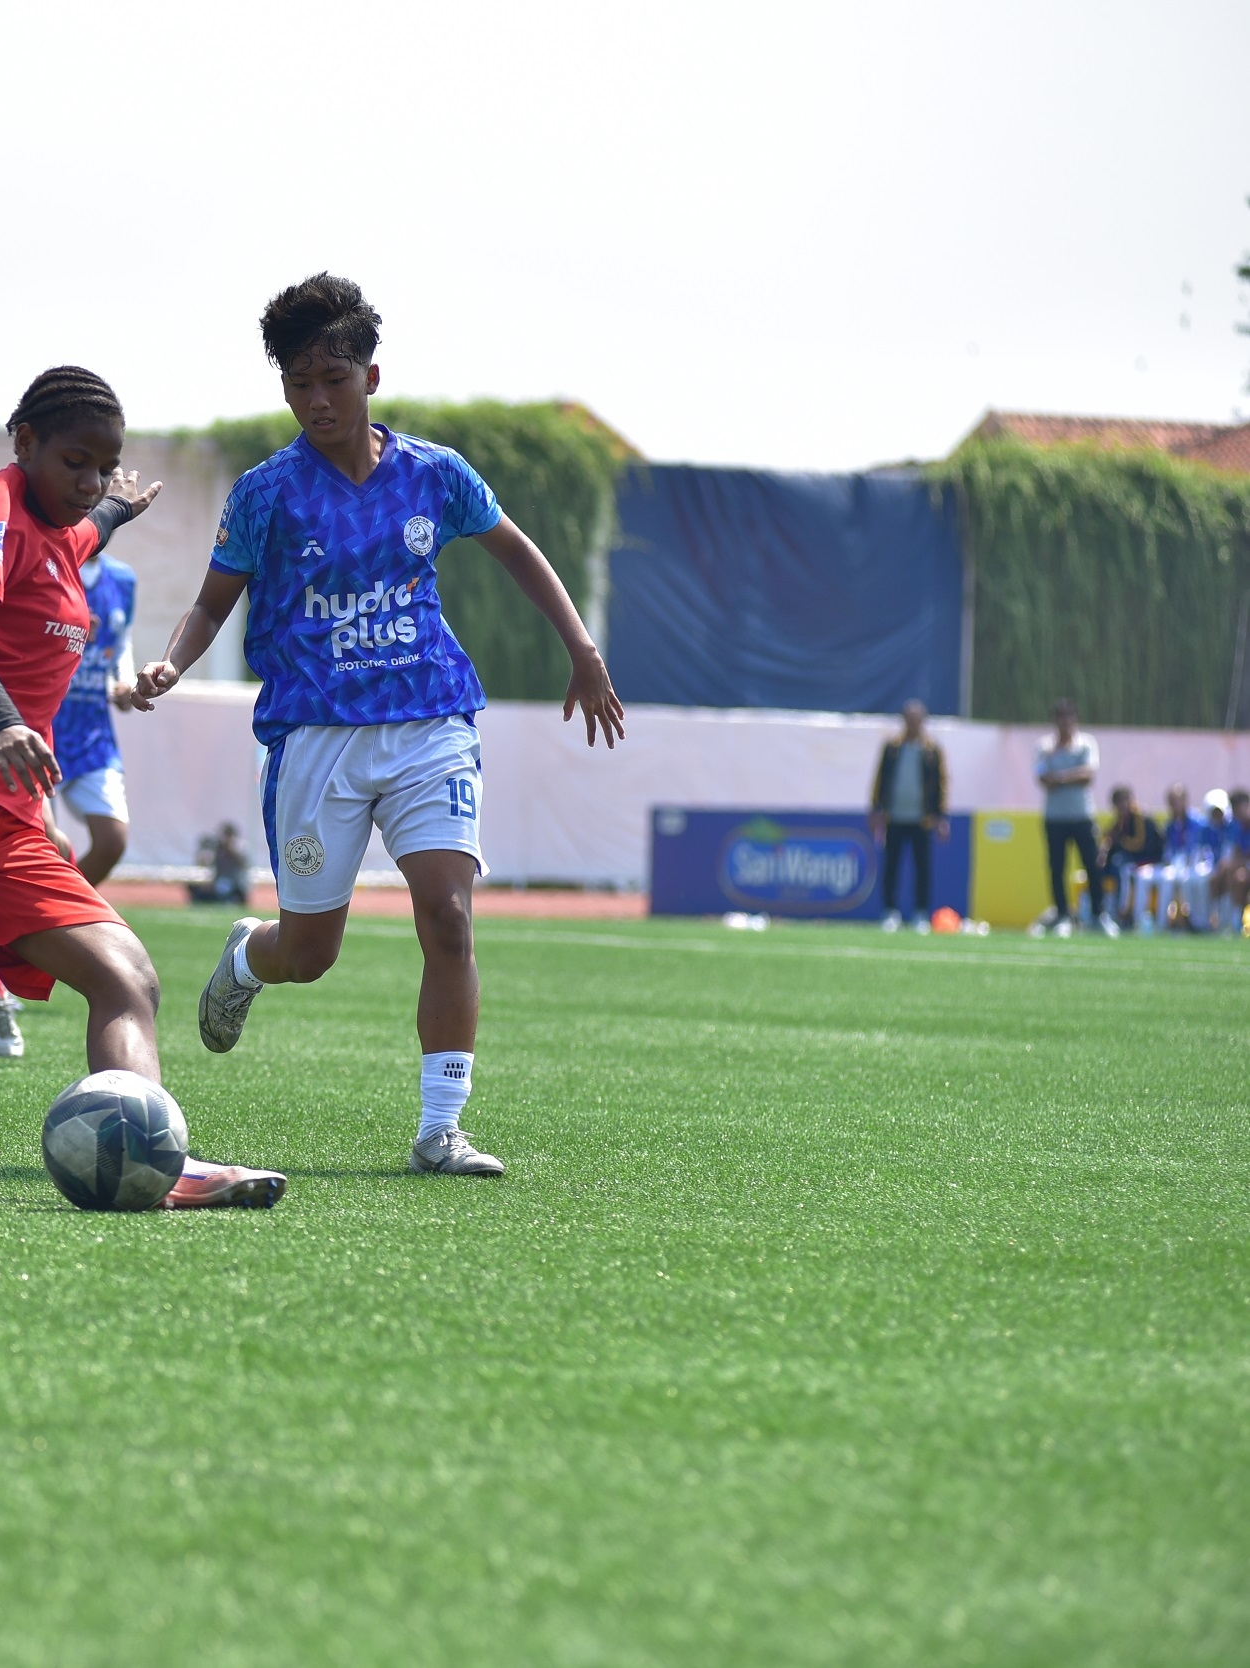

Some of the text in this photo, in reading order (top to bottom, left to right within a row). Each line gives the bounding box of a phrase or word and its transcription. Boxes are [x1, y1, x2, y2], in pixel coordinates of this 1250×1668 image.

[304, 579, 414, 628] hydro
[44, 621, 87, 642] TUNGGAL
[330, 615, 417, 659] plus
[445, 777, 477, 821] 19
